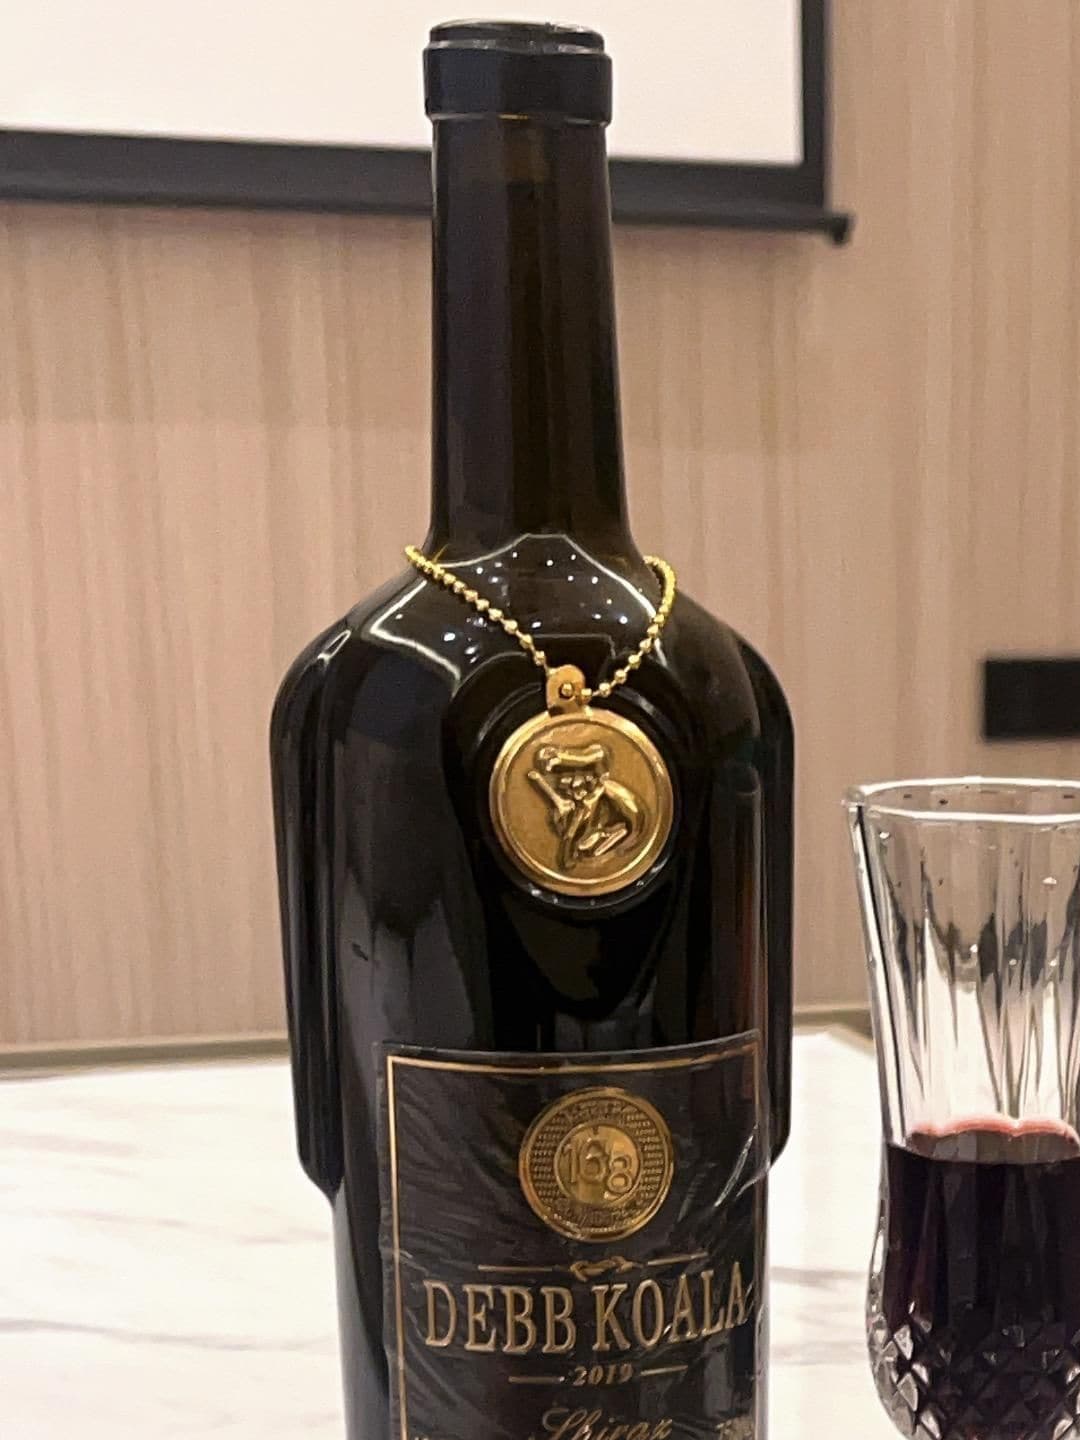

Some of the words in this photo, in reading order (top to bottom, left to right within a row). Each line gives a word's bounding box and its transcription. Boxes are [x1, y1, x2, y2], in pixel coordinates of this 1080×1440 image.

[423, 1280, 577, 1354] DEBB
[592, 1262, 751, 1352] KOALA
[573, 1363, 633, 1386] 2019
